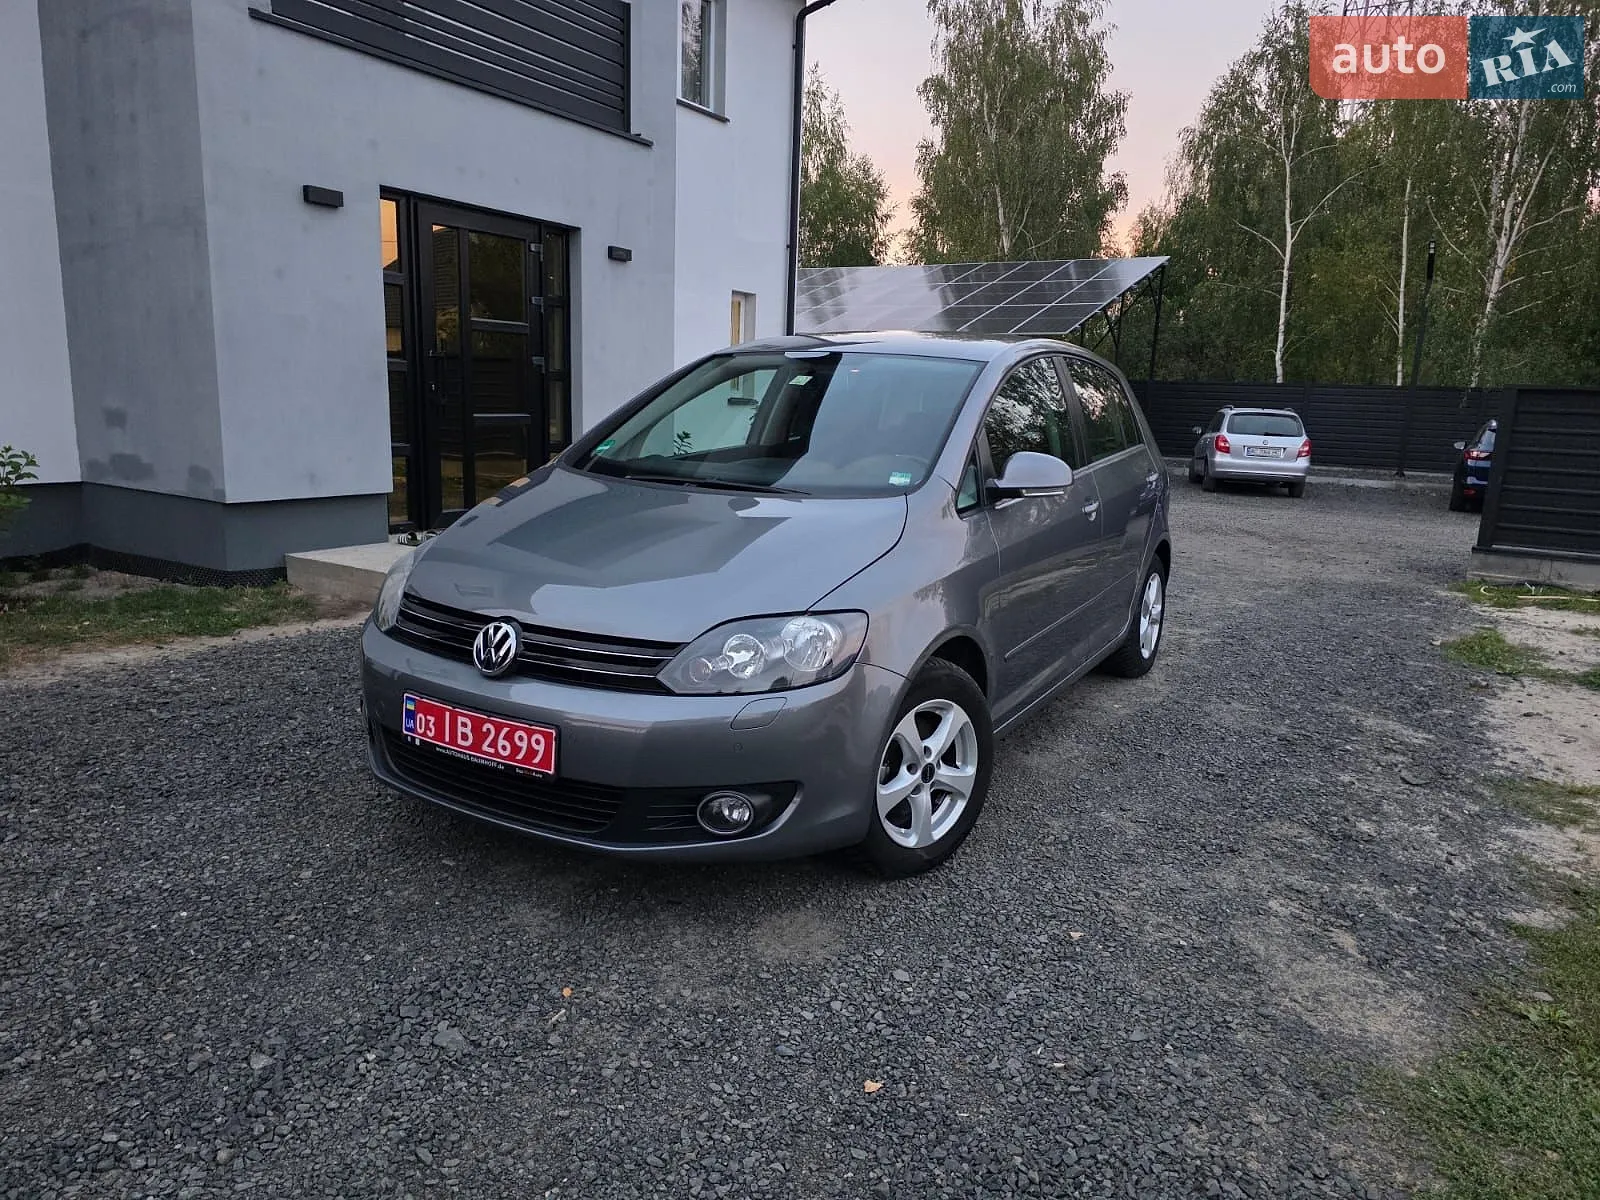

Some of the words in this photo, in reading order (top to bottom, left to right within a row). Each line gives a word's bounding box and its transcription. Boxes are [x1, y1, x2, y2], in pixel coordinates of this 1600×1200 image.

[405, 718, 415, 729] UA
[416, 713, 435, 737] 03
[444, 711, 473, 747] IB
[481, 722, 545, 764] 2699
